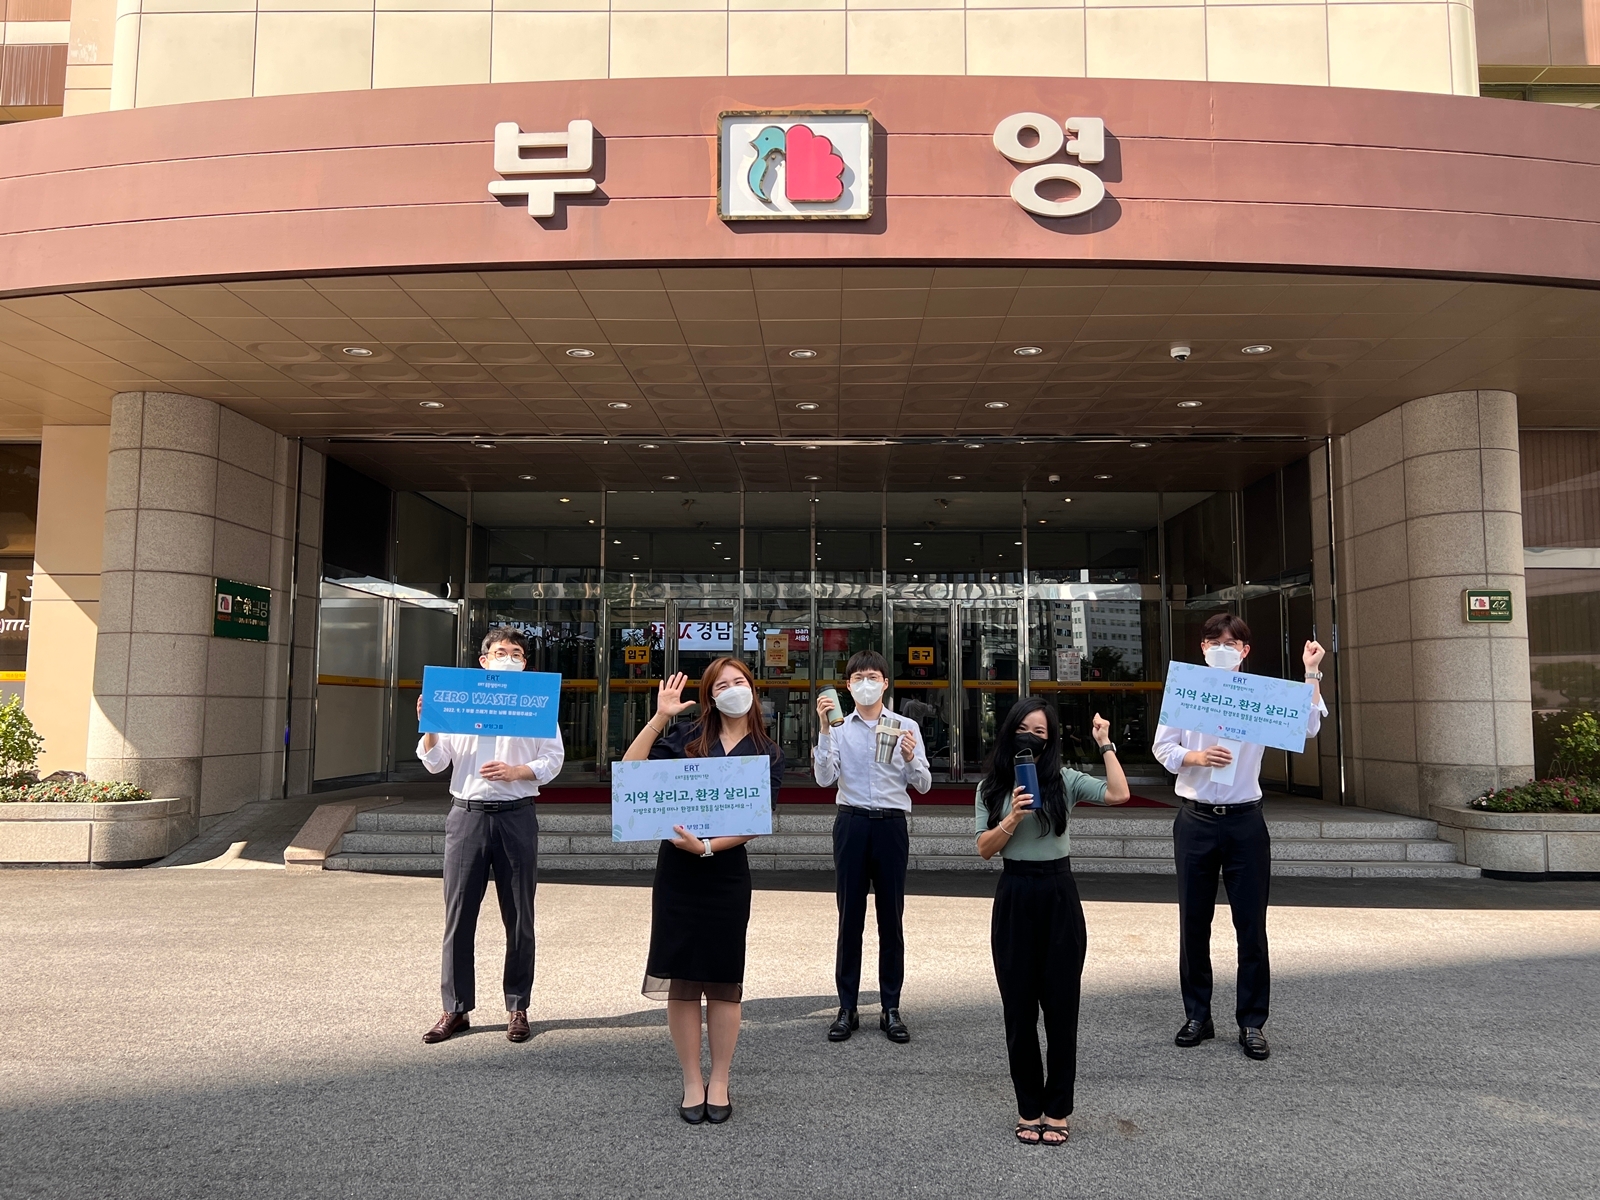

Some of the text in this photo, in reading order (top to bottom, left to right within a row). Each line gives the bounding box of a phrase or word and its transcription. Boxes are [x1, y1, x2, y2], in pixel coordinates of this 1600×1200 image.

[488, 112, 1104, 217] 부 영
[0, 618, 30, 634] )777-
[628, 650, 647, 660] 입구
[912, 650, 930, 660] 출구
[1232, 676, 1248, 684] ERT
[433, 690, 549, 708] ZERO WASTE DAY
[1175, 688, 1299, 719] 지역 살리고, 환경 살리고
[684, 764, 700, 772] ERT
[624, 786, 760, 804] 지역 살리고, 환경 살리고
